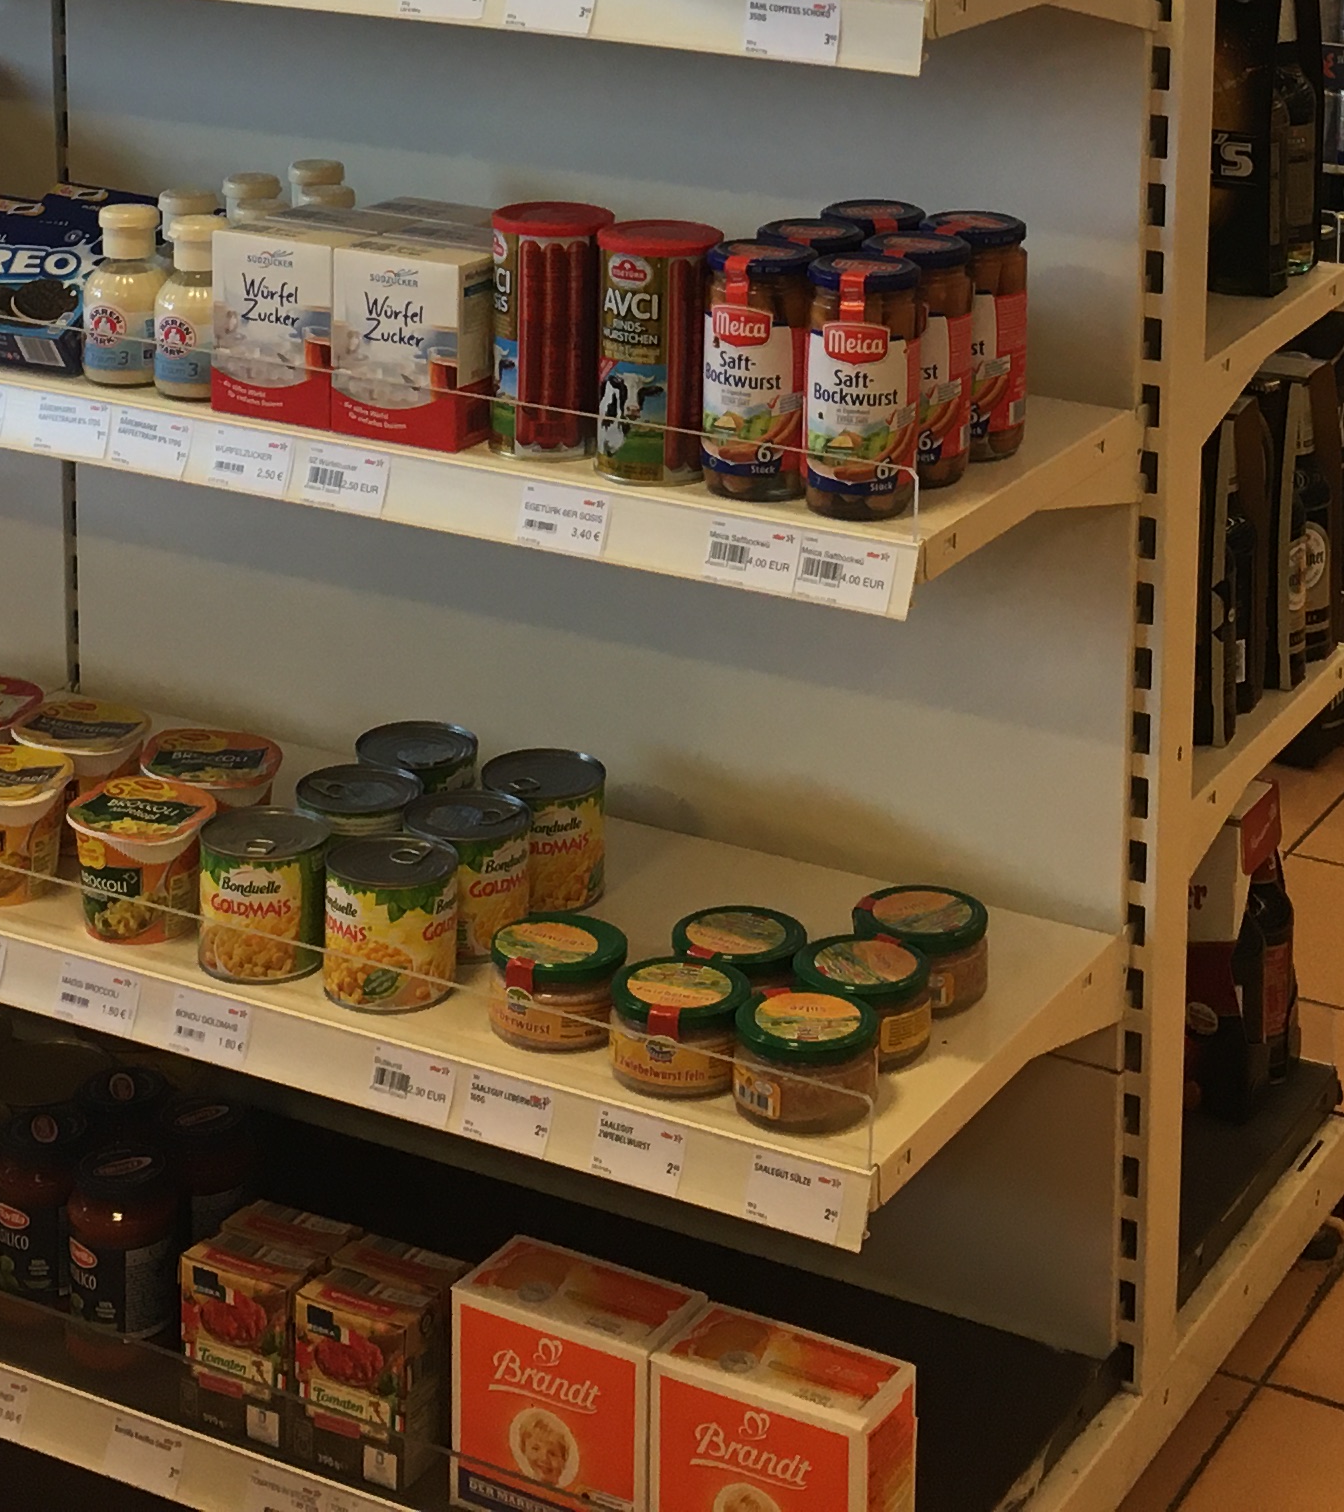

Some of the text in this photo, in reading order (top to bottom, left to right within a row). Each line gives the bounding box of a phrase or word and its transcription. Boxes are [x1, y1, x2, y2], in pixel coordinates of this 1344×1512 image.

[749, 1, 767, 13] BAHL
[768, 3, 801, 16] COMTESS
[247, 254, 294, 269] SÜDZUCKER
[241, 272, 299, 306] Würfel
[369, 272, 419, 288] SÜDZUCKER
[241, 298, 300, 329] Zucker
[363, 291, 424, 326] Würfel
[603, 288, 659, 321] AVCI
[362, 317, 425, 350] Zucker
[714, 310, 767, 339] Meica
[828, 328, 886, 355] Meica
[187, 362, 199, 378] 3
[719, 351, 757, 371] Saft-
[705, 361, 782, 390] Bockwurst
[833, 369, 875, 389] Saft-
[813, 382, 899, 406] Bockwurst
[757, 442, 772, 464] 6
[256, 467, 275, 481] 2,50
[571, 526, 600, 542] 3,40 €
[221, 875, 282, 896] Bonduelle
[615, 1055, 674, 1081] Zwiebelwurst
[754, 1161, 812, 1188] SAALEGUT SÜLZE
[198, 1345, 248, 1376] Tomaten
[492, 1348, 602, 1410] Brandt
[311, 1384, 365, 1418] Tomaten
[694, 1421, 813, 1487] Brandt
